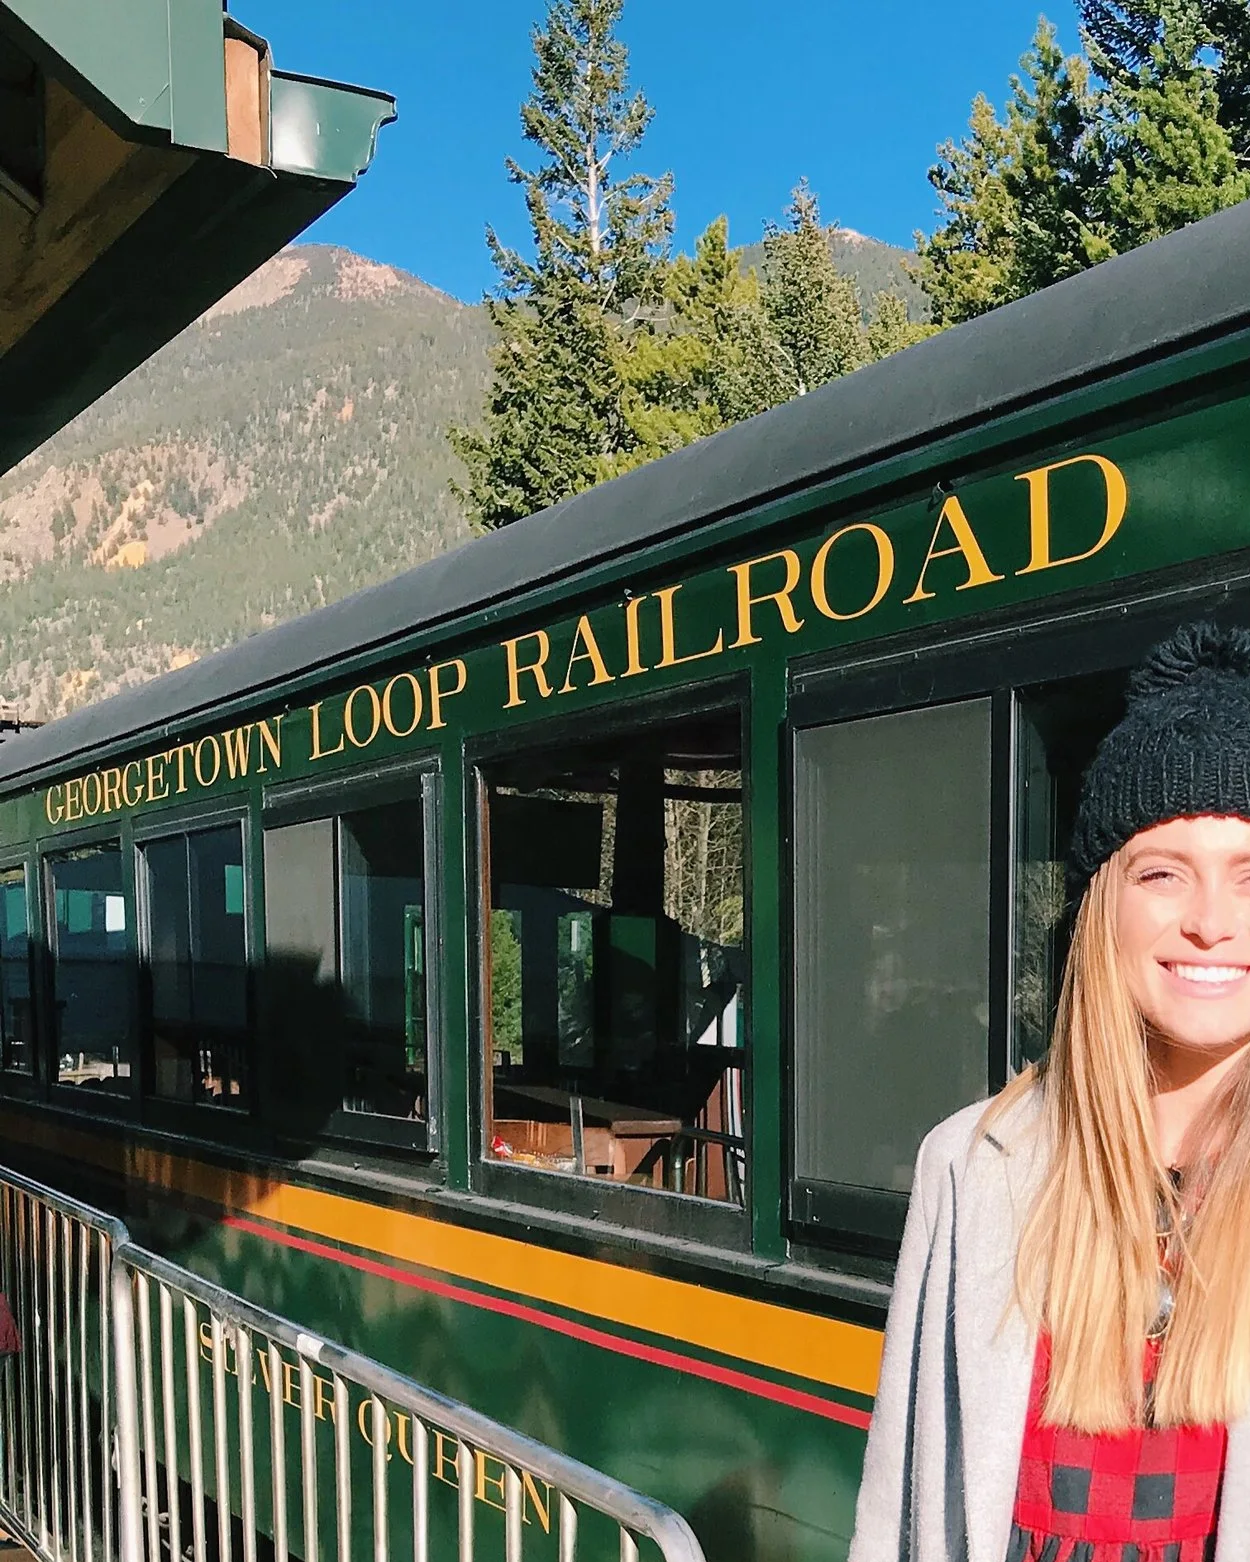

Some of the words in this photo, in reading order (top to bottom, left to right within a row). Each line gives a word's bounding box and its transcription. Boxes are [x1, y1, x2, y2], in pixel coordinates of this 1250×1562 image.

[45, 714, 285, 826] GEORGETOWN
[308, 659, 467, 761] LOOP
[500, 453, 1129, 709] RAILROAD
[358, 1399, 555, 1535] QUEEN
